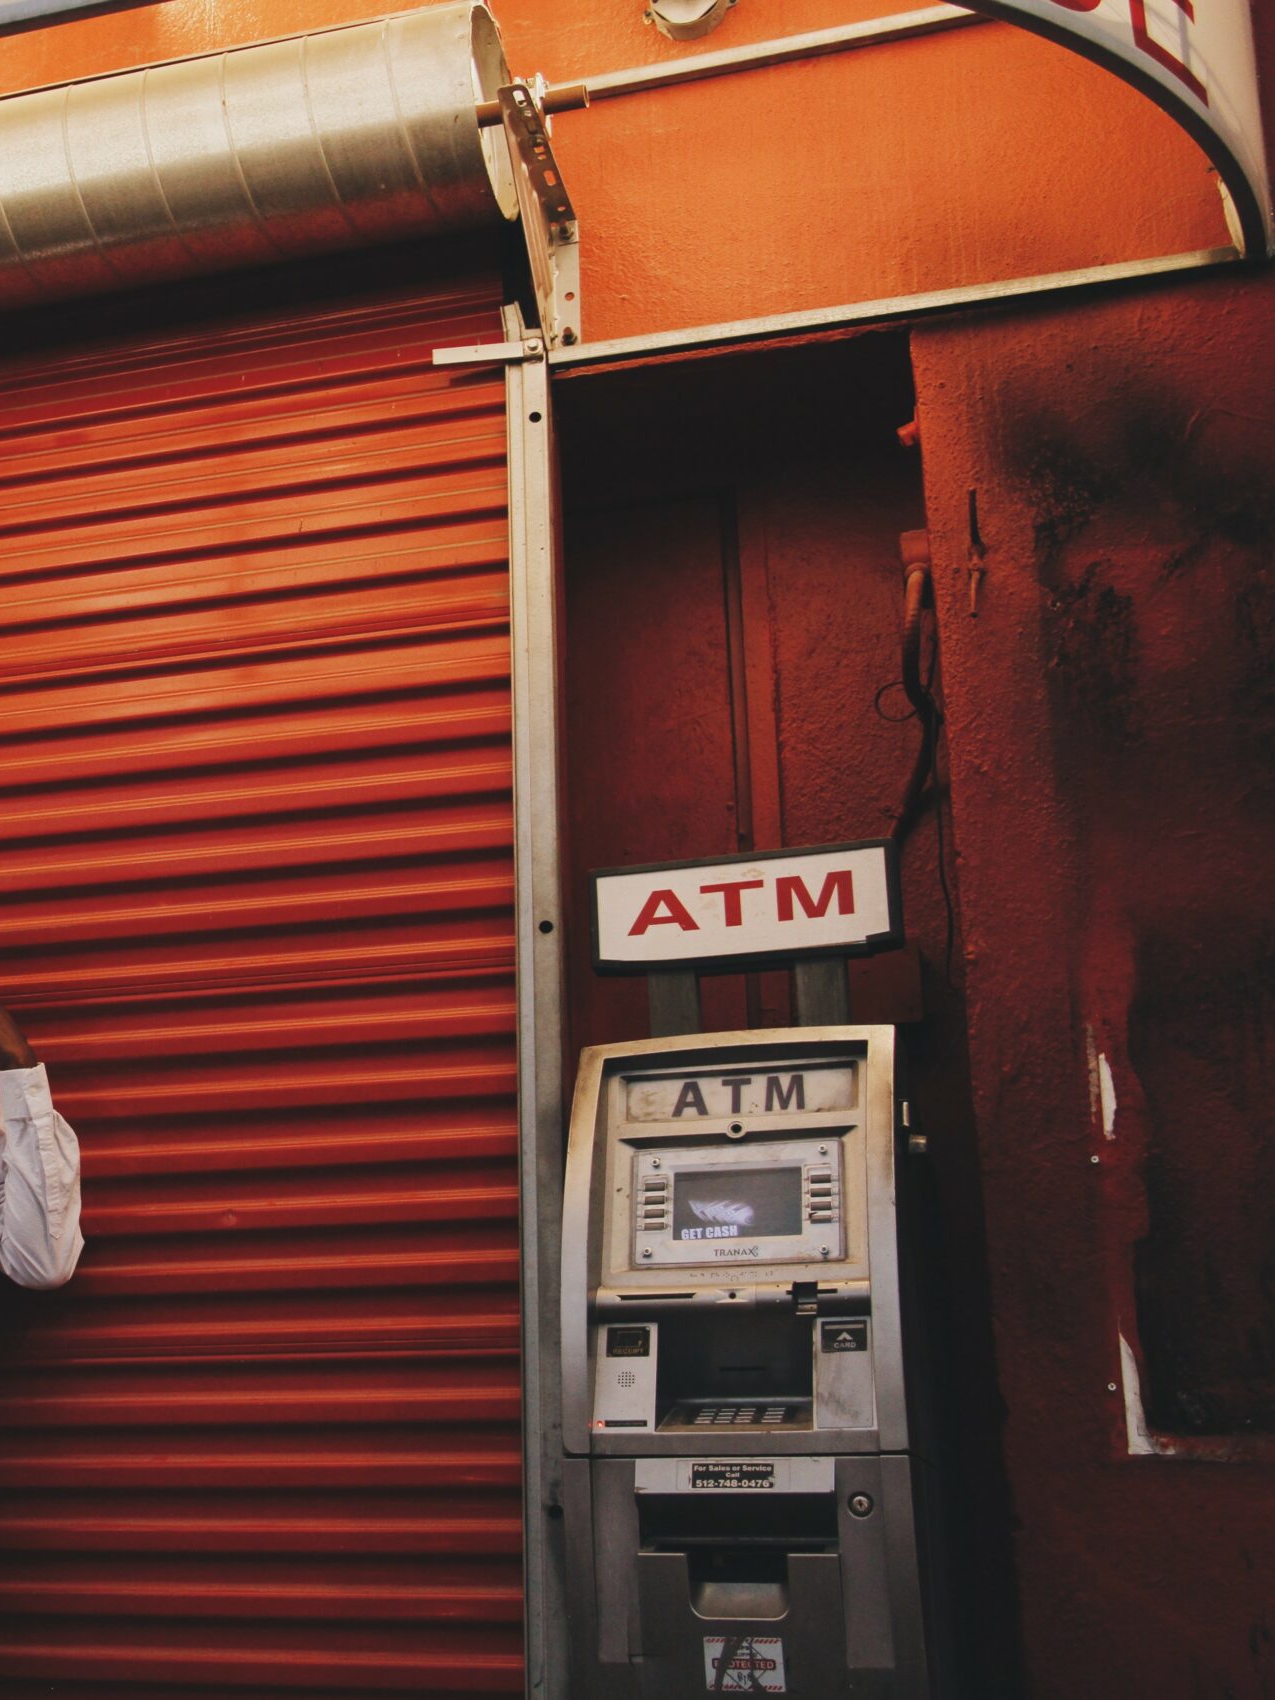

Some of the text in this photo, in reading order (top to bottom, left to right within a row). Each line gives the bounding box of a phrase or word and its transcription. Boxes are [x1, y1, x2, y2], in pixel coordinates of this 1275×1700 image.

[627, 869, 856, 936] ATM
[671, 1073, 806, 1118] ATM
[680, 1225, 738, 1241] GET CASH
[713, 1246, 759, 1258] TRANAX
[833, 1341, 857, 1349] CARD
[695, 1479, 770, 1488] 512-748-0476
